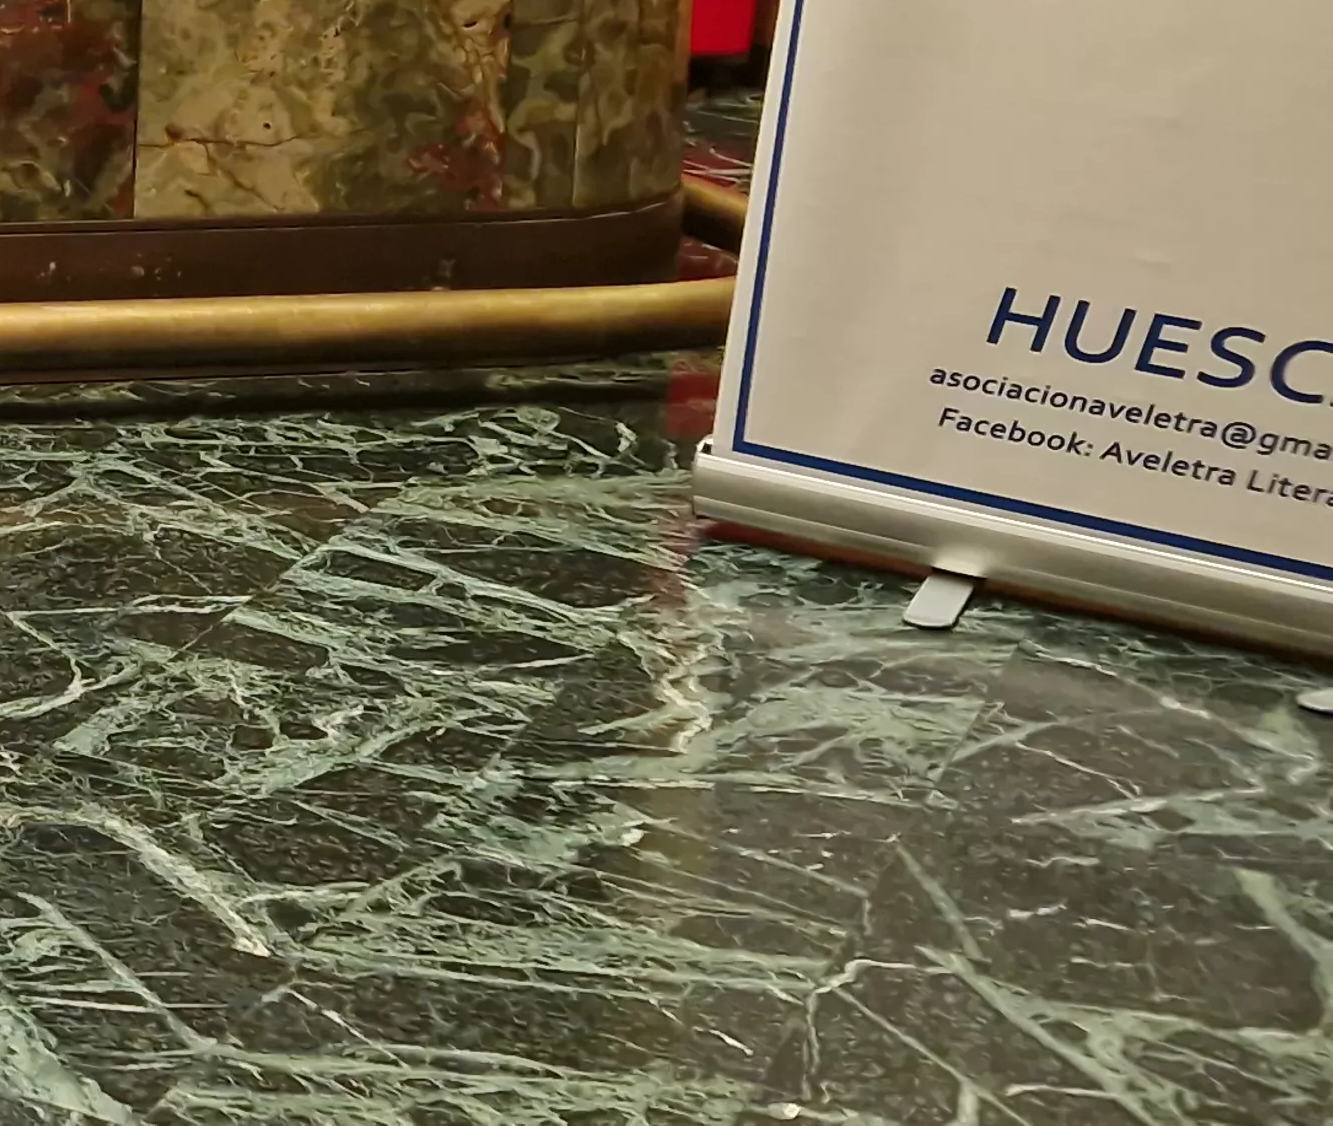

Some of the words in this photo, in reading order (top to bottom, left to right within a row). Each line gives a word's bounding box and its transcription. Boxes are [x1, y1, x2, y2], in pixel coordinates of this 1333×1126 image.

[986, 286, 1333, 408] HUESC
[929, 368, 1332, 461] asociacionaveletra@gma
[938, 407, 1094, 457] Facebook:
[1098, 441, 1237, 486] Aveletra
